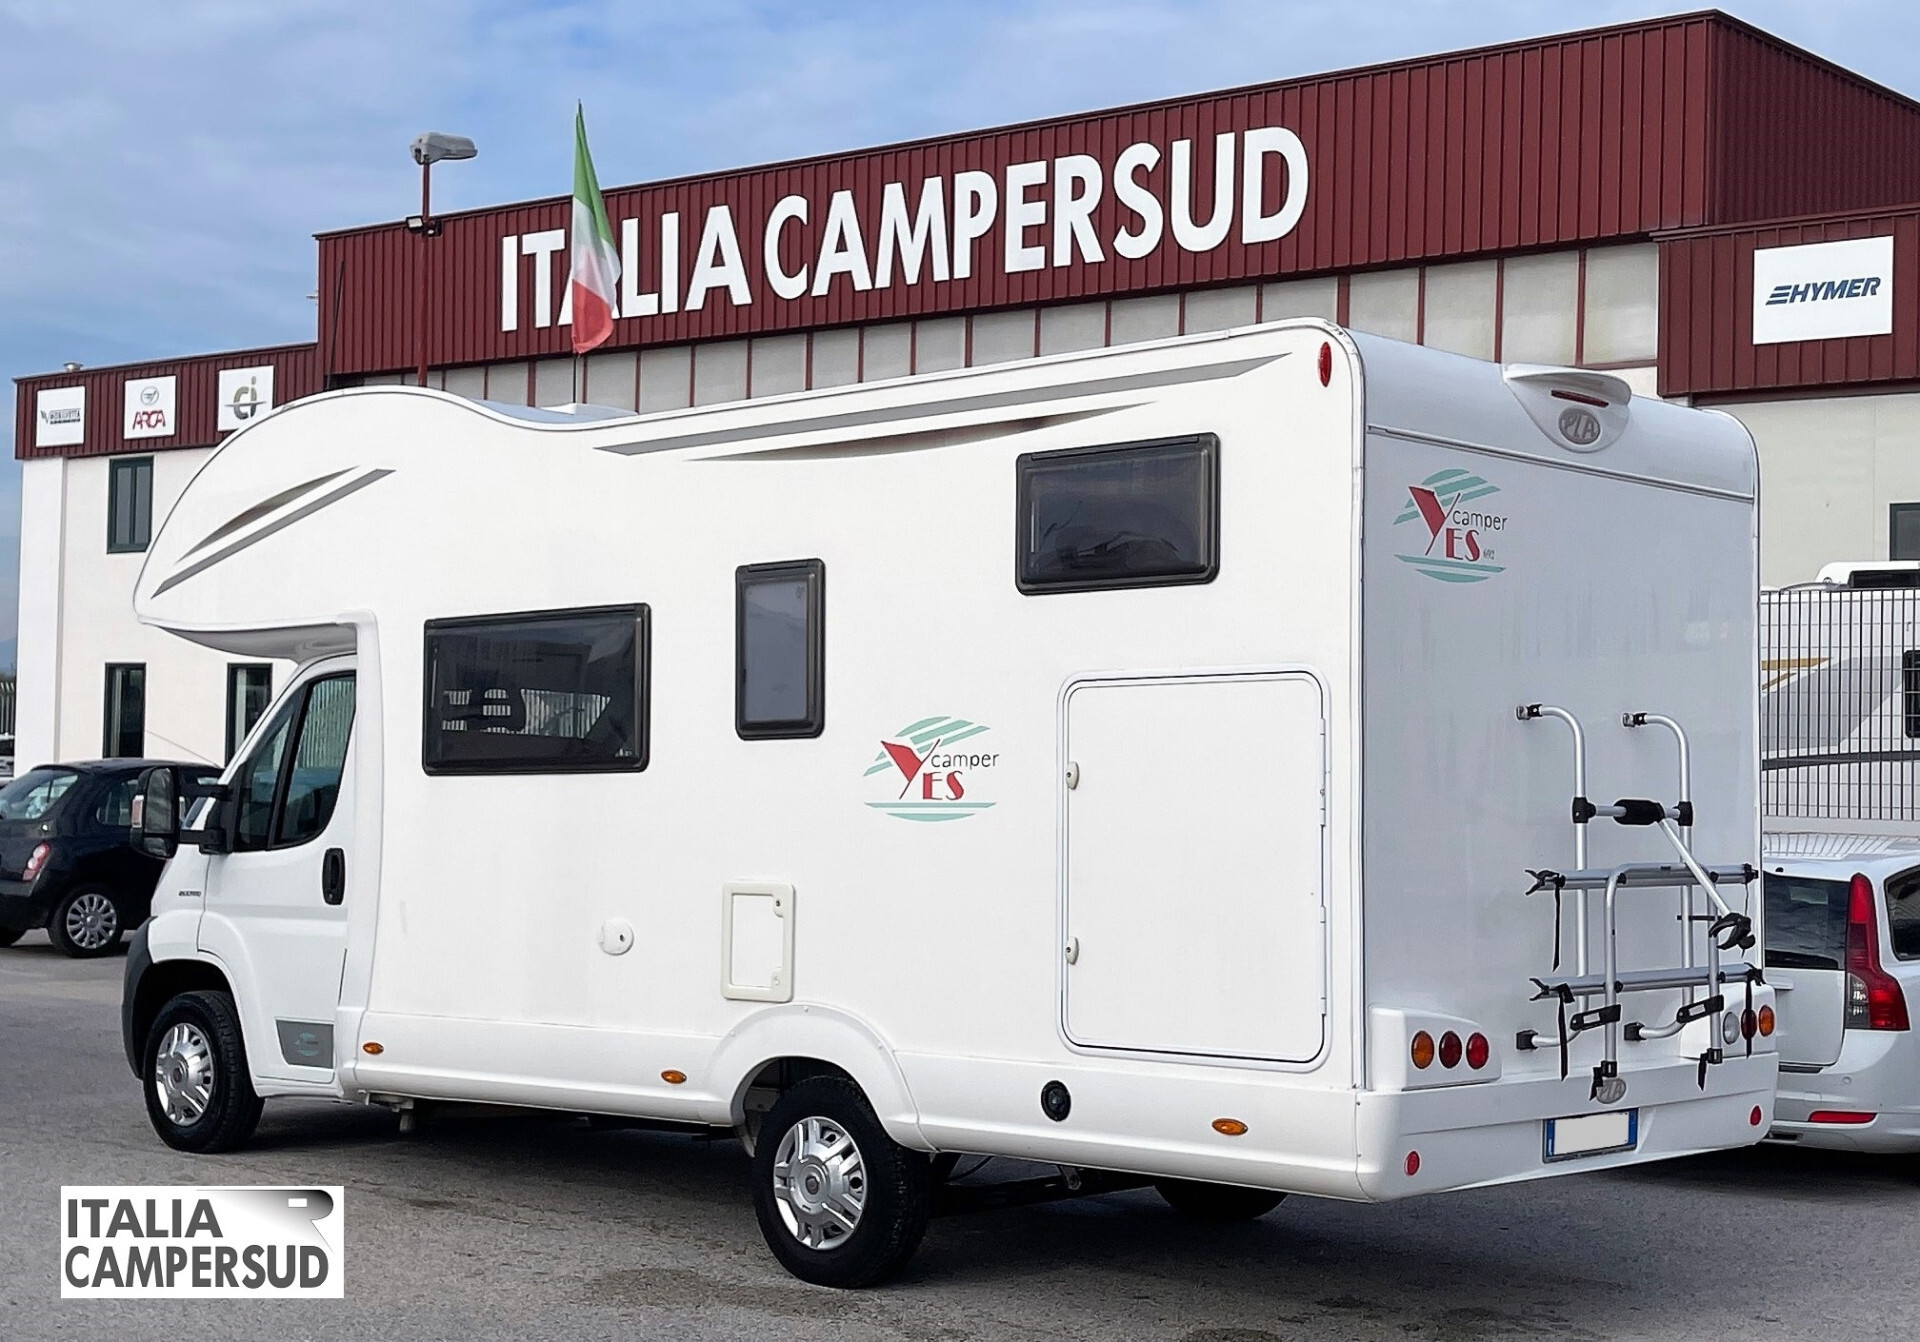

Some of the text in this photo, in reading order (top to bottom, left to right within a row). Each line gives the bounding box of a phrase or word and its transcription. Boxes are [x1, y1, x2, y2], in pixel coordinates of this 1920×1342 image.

[502, 125, 1309, 332] ITLIA CAMPERSUD
[1788, 276, 1881, 304] HYMER
[132, 409, 166, 430] ARCA
[1408, 486, 1481, 562] YES
[1453, 509, 1508, 531] camper
[880, 738, 965, 801] YES
[930, 753, 1000, 770] camper
